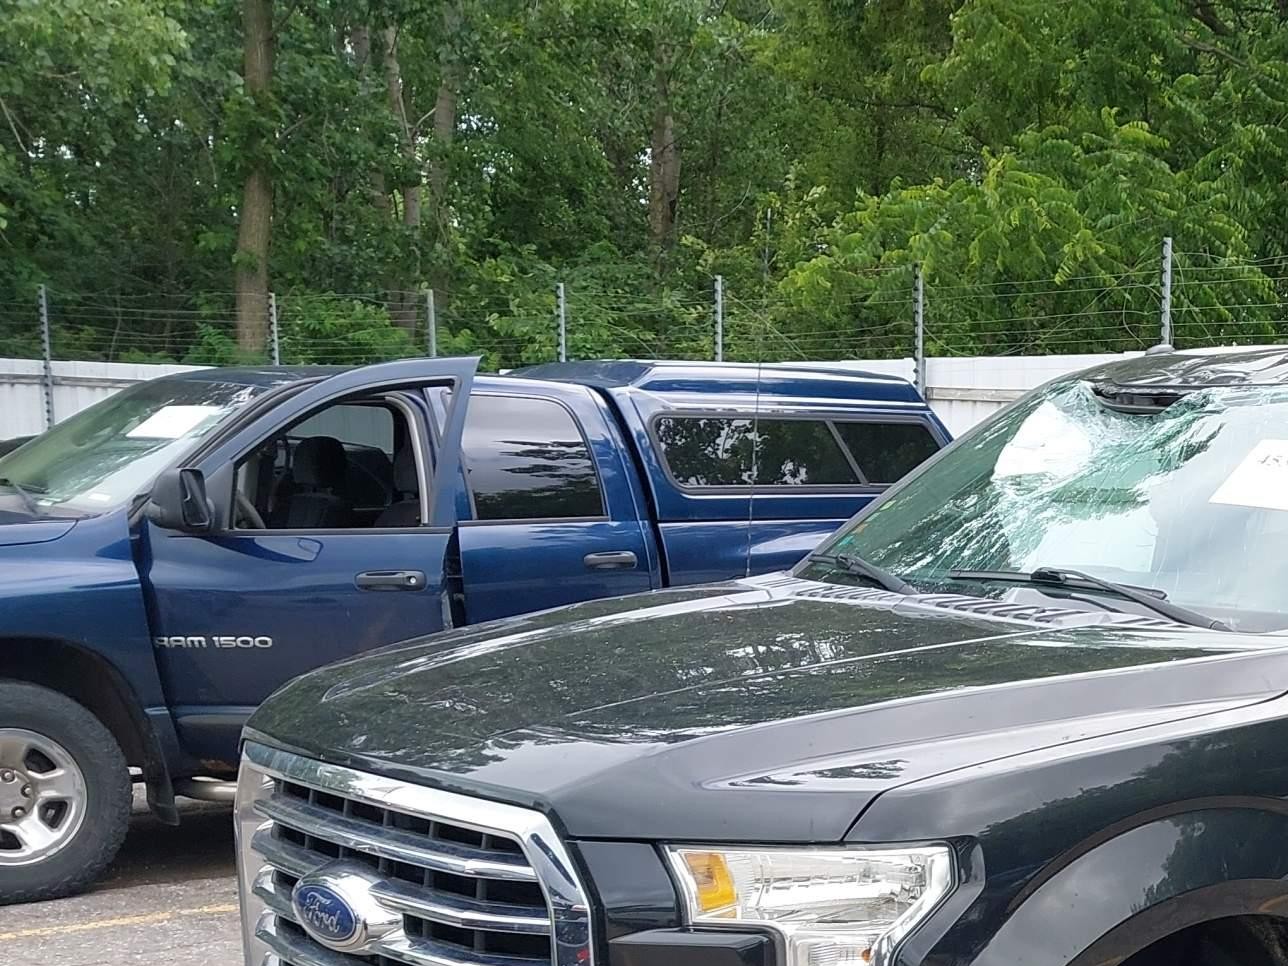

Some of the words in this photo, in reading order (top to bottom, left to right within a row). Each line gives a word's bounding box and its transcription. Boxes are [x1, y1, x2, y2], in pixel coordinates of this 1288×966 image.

[154, 636, 207, 648] RAM
[211, 636, 273, 648] 1500
[303, 891, 341, 934] Ford
